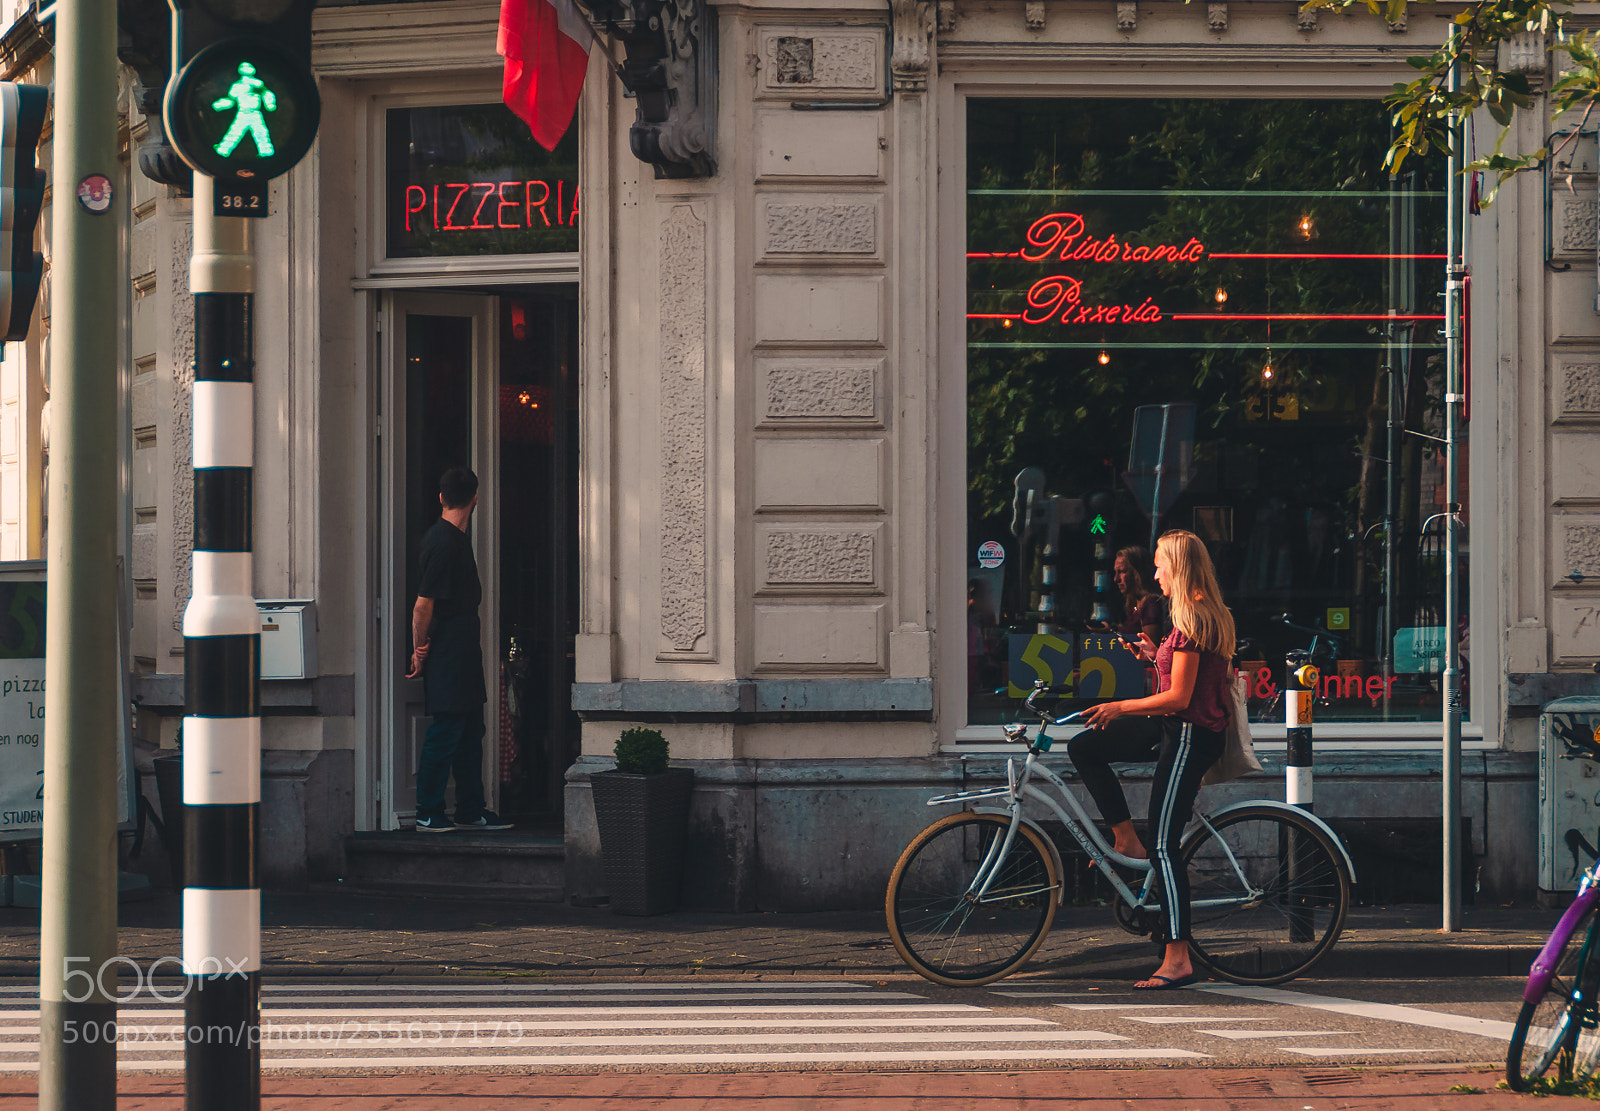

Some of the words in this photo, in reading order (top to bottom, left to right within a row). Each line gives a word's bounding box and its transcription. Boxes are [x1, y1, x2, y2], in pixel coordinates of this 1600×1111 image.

[222, 195, 259, 208] 38.2
[1020, 212, 1204, 262] Ristorante
[1414, 639, 1441, 648] AIRCO
[17, 734, 39, 748] nog
